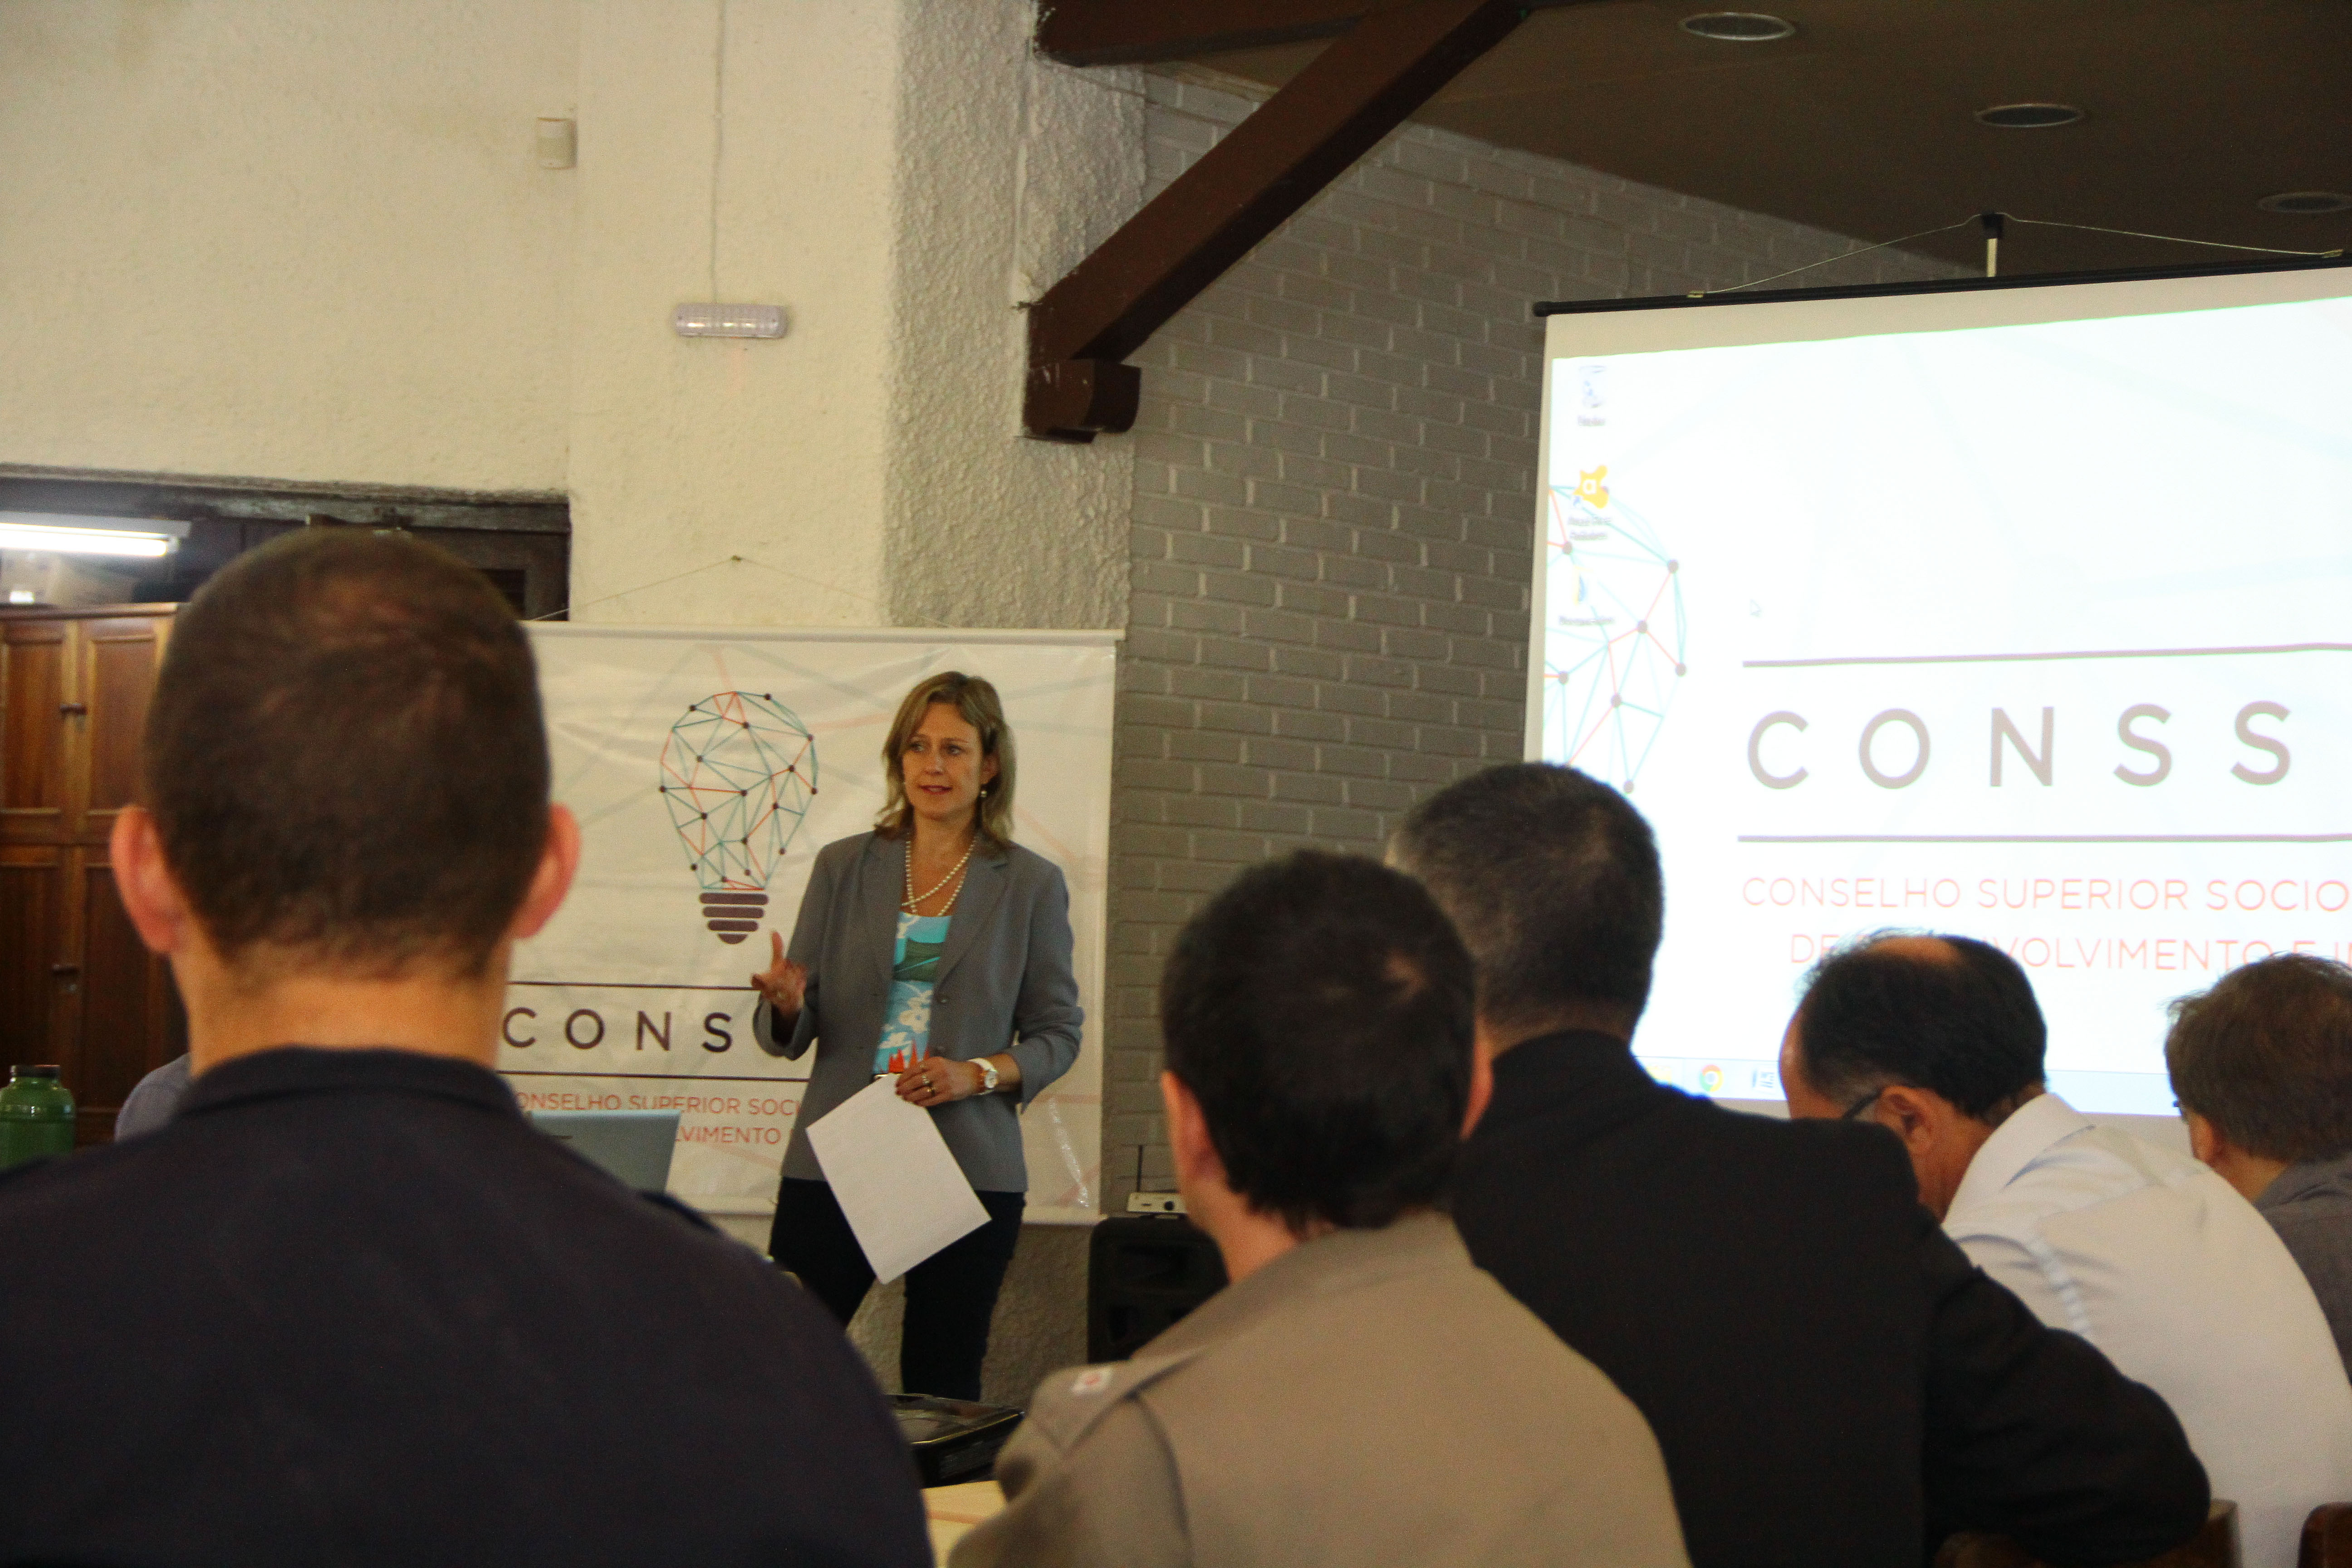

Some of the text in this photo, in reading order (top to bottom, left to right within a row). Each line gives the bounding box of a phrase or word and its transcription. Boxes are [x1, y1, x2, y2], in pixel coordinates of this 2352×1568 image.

[1747, 701, 2291, 789] CONSS
[1743, 877, 2350, 911] CONSELHO SUPERIOR SOCIO
[1992, 937, 2273, 970] VOLVIMENTO
[502, 1007, 733, 1052] CONS
[516, 1092, 800, 1116] ONSELHO SUPERIOR SOCI
[676, 1126, 781, 1145] VIMENTO
